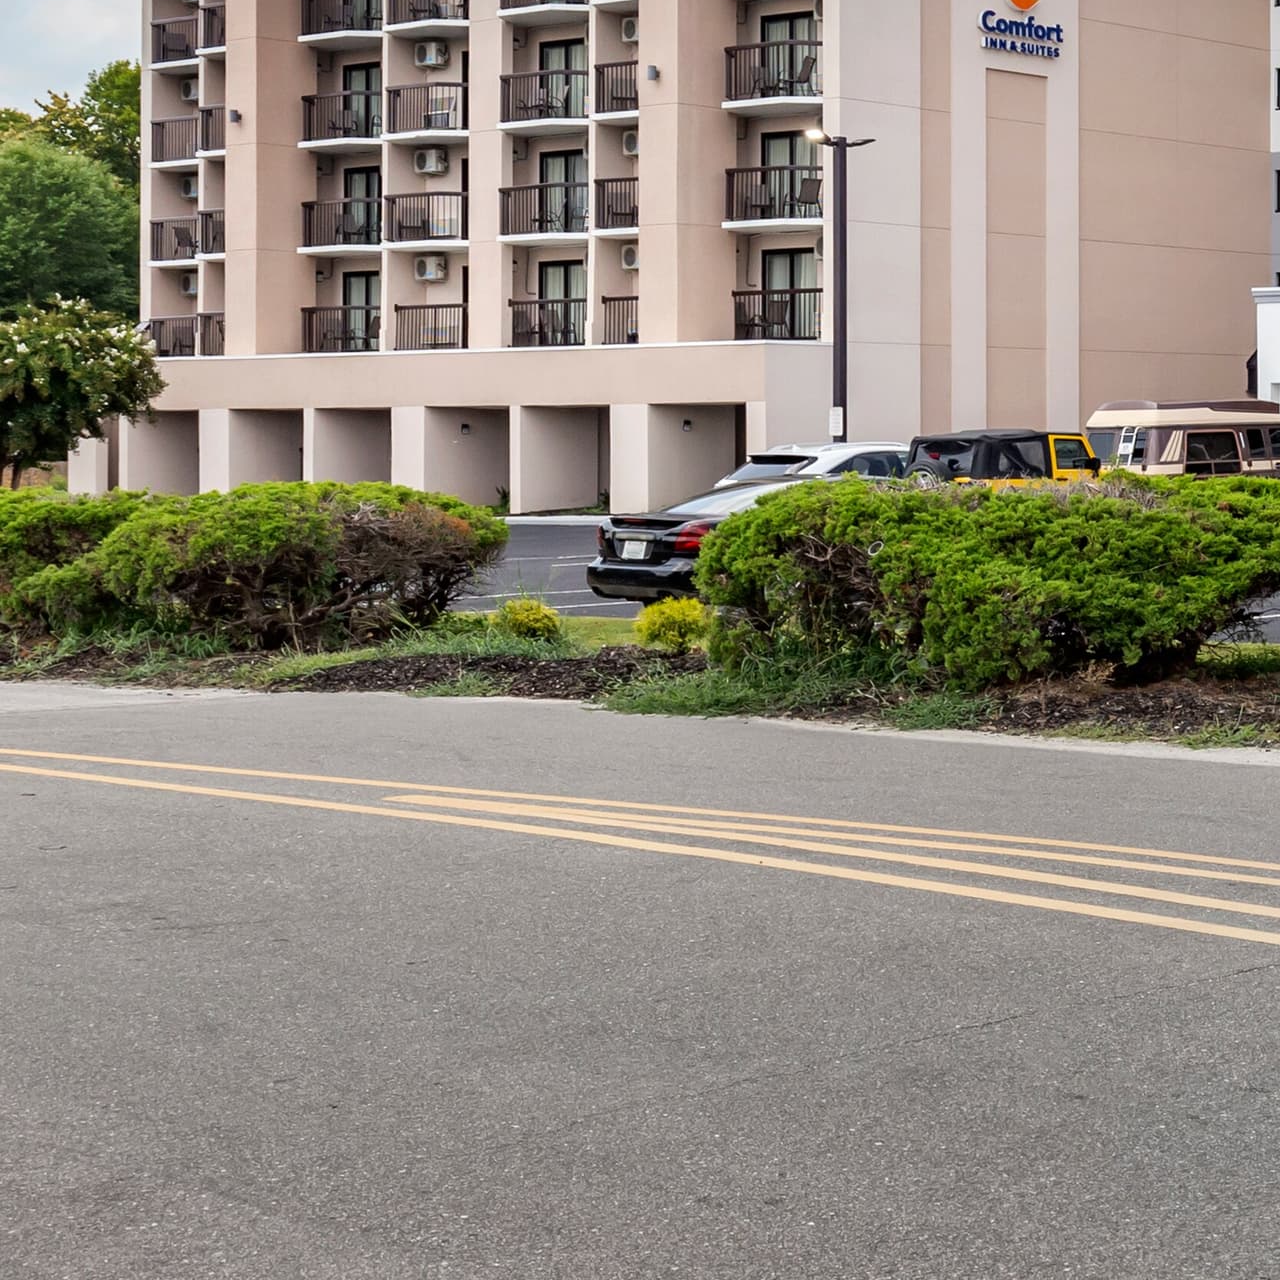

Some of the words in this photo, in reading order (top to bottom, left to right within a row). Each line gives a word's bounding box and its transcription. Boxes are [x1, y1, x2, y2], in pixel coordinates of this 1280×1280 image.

[979, 10, 1063, 43] Comfort
[983, 36, 1007, 50] INN
[1009, 41, 1018, 51] &
[1020, 42, 1060, 58] SUITES
